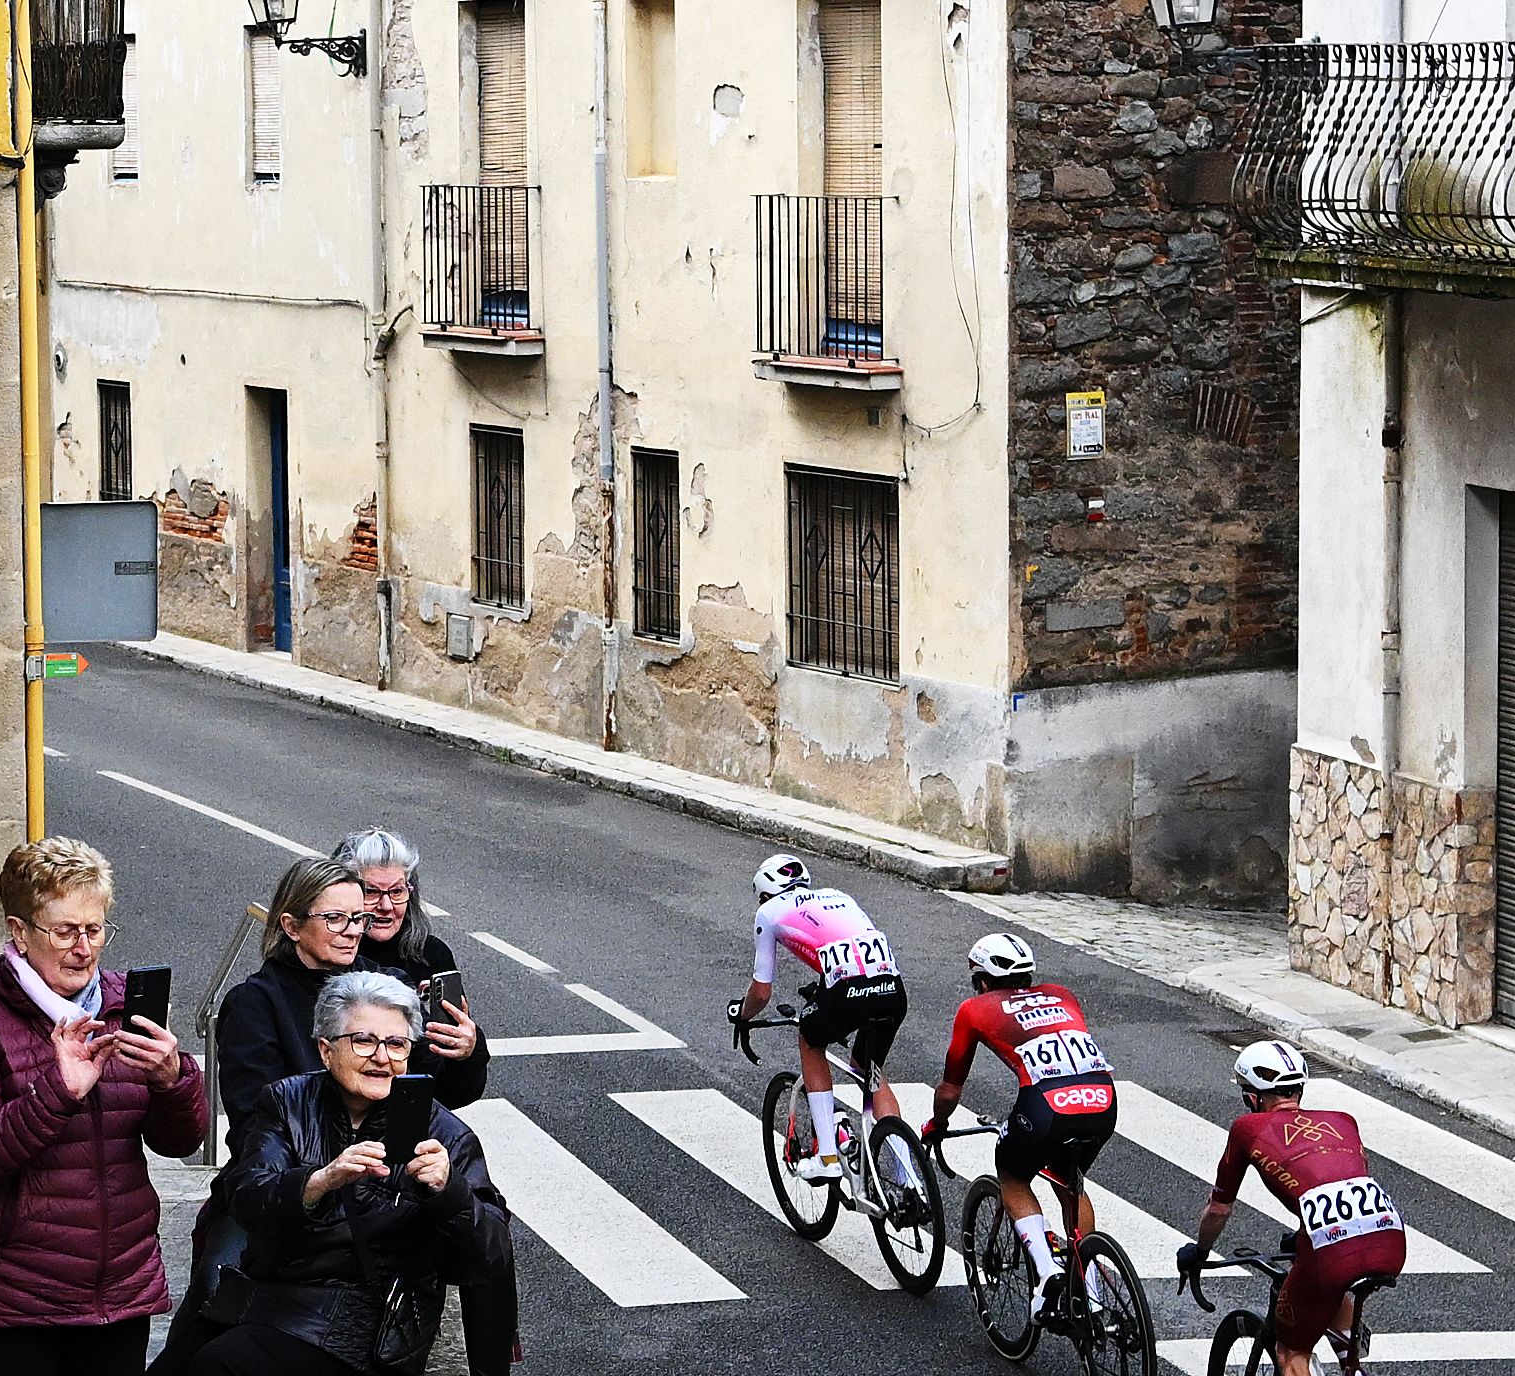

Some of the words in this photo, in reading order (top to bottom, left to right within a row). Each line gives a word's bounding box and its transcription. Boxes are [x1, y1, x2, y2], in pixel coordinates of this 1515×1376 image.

[820, 943, 851, 975] 217
[846, 981, 897, 998] Burpellet
[1024, 1039, 1062, 1067] 167
[1069, 1036, 1098, 1059] 16
[1053, 1088, 1108, 1108] caps
[1251, 1149, 1299, 1189] FACTOR
[1304, 1190, 1353, 1231] 226
